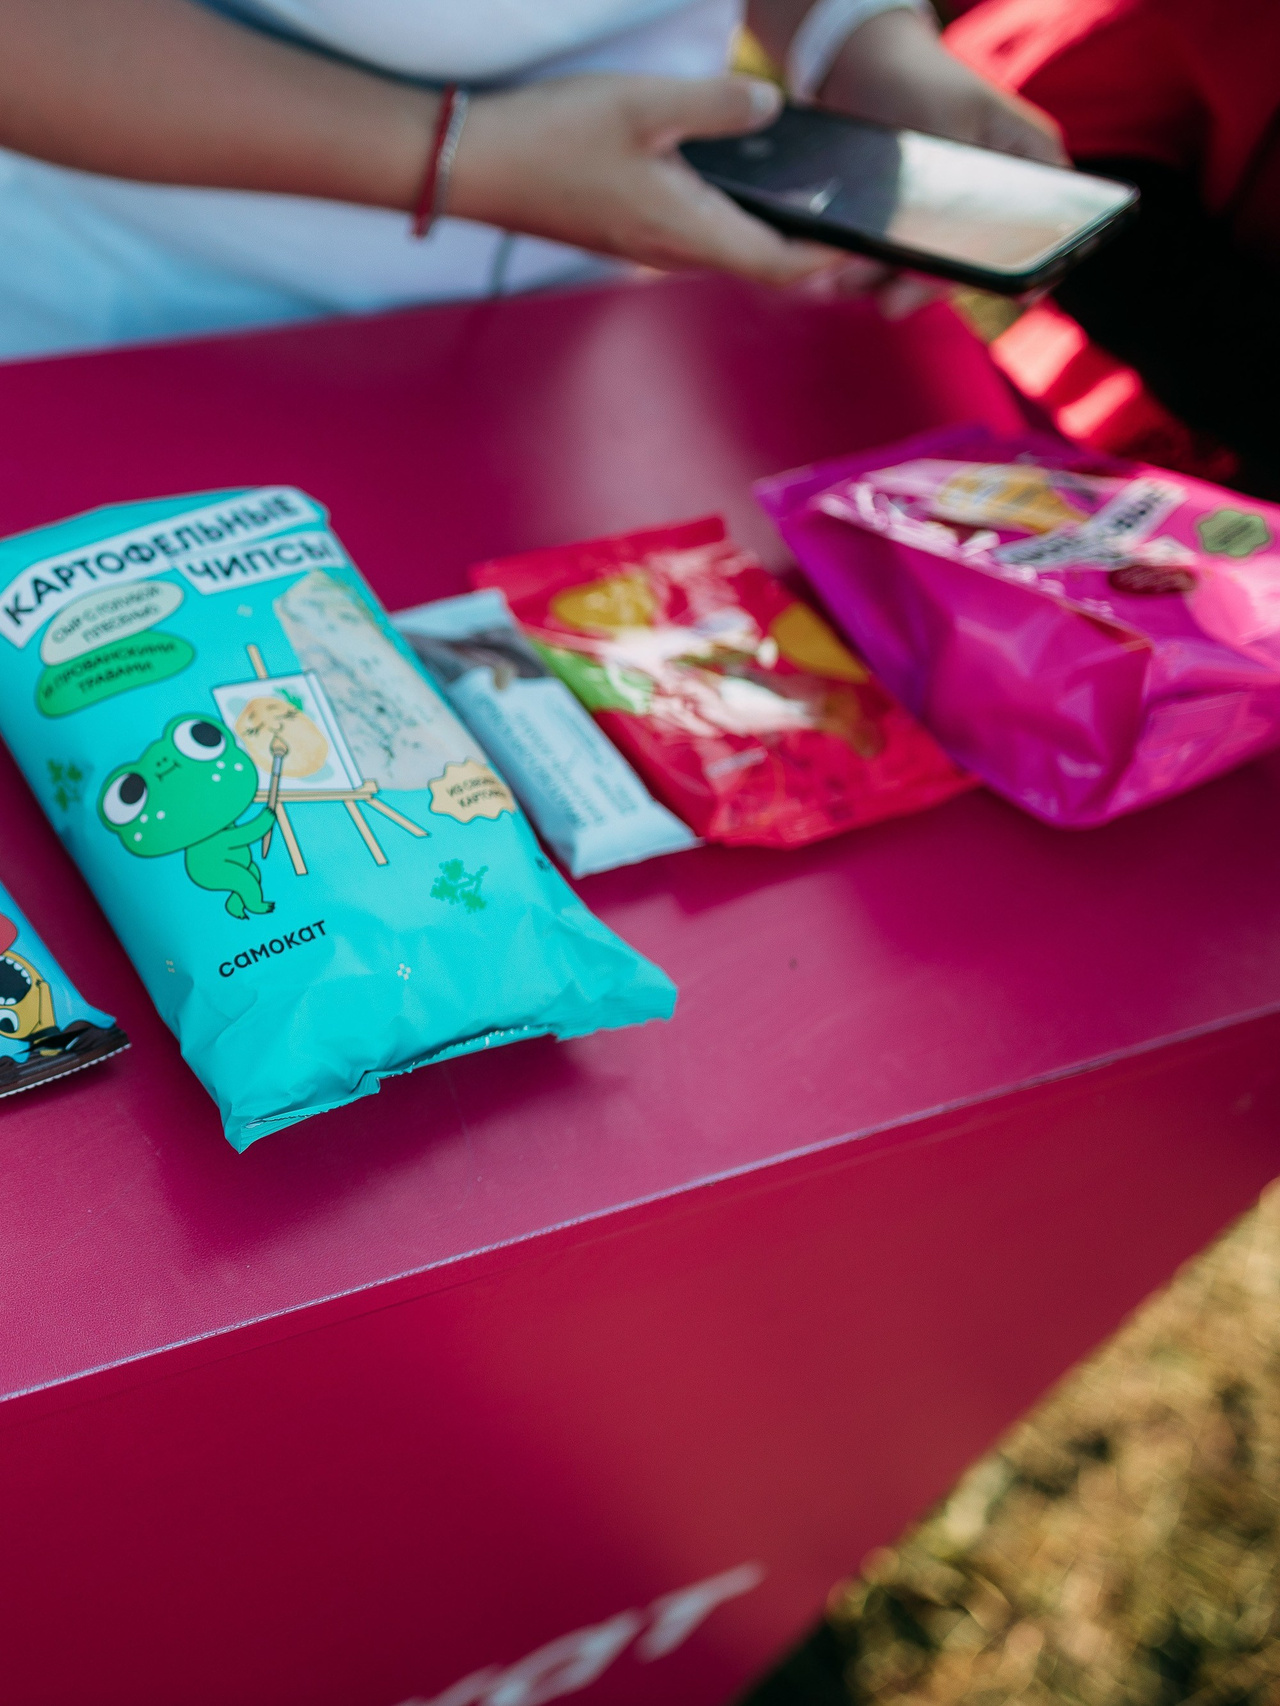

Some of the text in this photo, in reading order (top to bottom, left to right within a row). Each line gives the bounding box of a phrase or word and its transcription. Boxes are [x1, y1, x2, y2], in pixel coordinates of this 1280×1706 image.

[4, 493, 300, 626] КАРТОФЕЛЬНЫЕ
[185, 538, 336, 583] ЧИПСЫ
[218, 919, 326, 978] самокат
